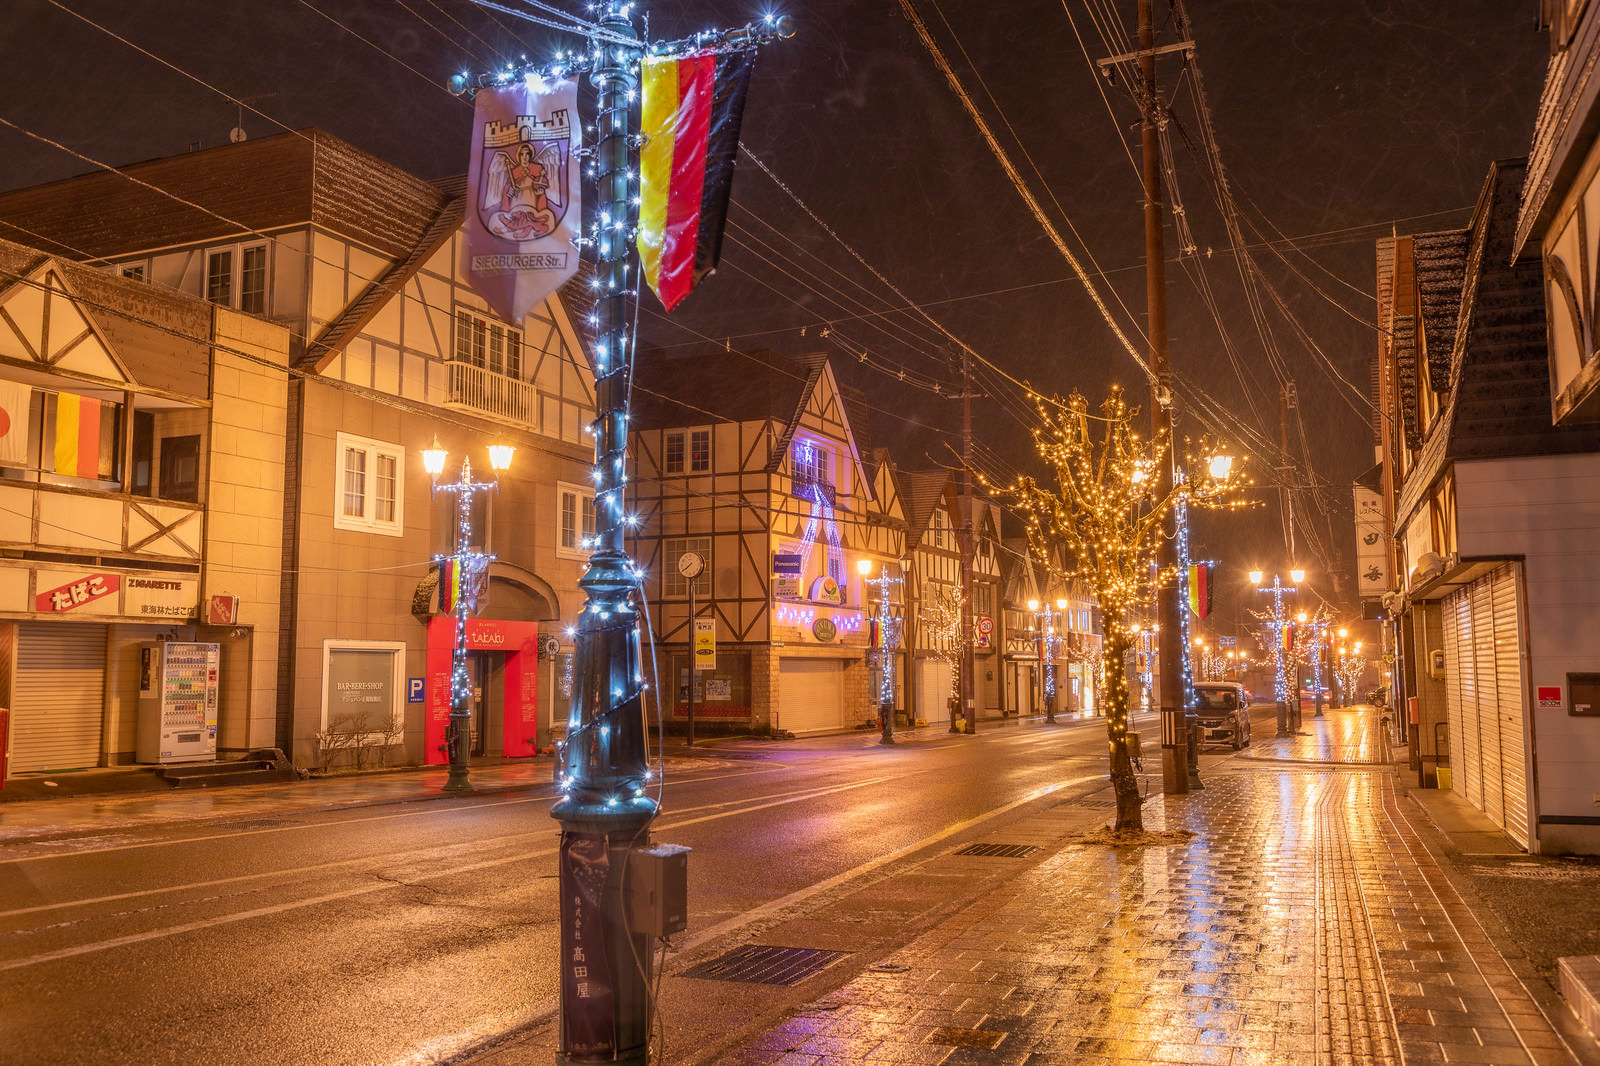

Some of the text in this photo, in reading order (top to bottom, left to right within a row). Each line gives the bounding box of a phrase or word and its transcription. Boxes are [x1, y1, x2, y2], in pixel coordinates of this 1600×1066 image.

[475, 255, 544, 268] SIEGBURGER
[128, 578, 181, 590] ZIGARETTE
[52, 575, 108, 611] たばこ
[140, 604, 195, 616] 東海林たばこ店
[981, 622, 991, 631] 30
[410, 679, 423, 697] P
